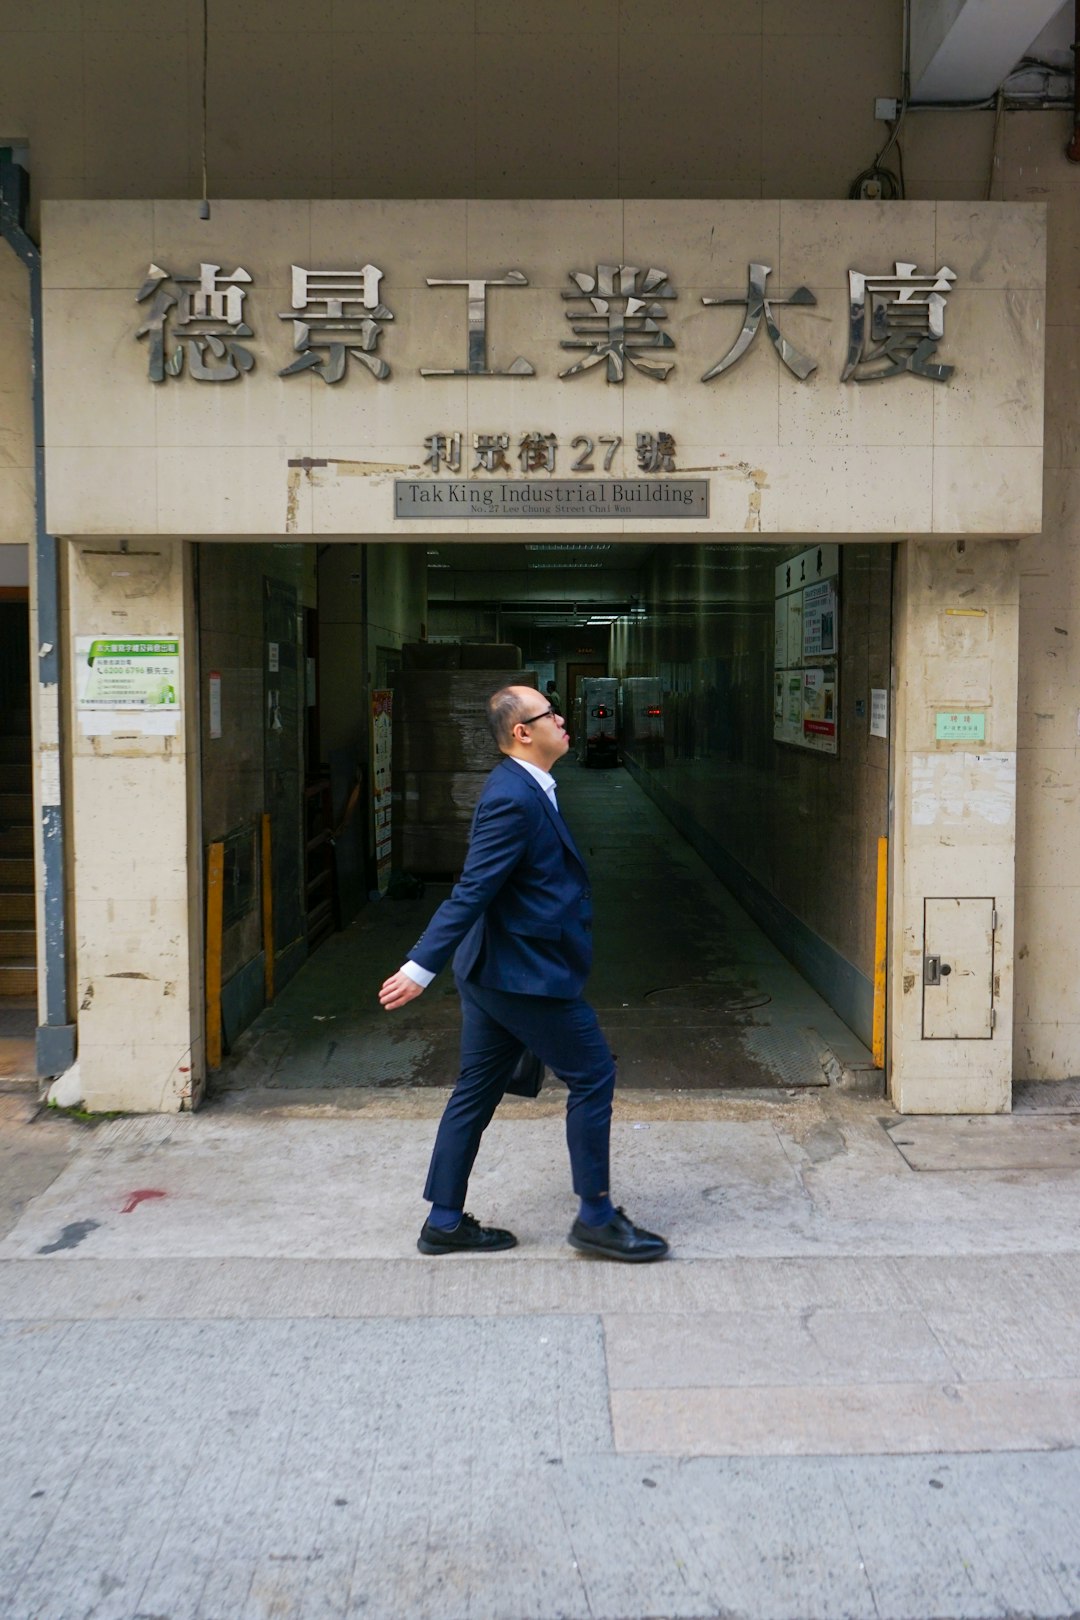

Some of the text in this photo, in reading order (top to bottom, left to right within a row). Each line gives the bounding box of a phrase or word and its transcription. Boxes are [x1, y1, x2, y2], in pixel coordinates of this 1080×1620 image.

[135, 261, 957, 384] 德景工業大廈
[409, 484, 694, 505] Tak King Industrial Building
[503, 505, 519, 513] Lee
[522, 505, 551, 513] Chung
[555, 505, 585, 513] Street
[589, 505, 611, 513] Chai
[614, 505, 632, 513] Wan
